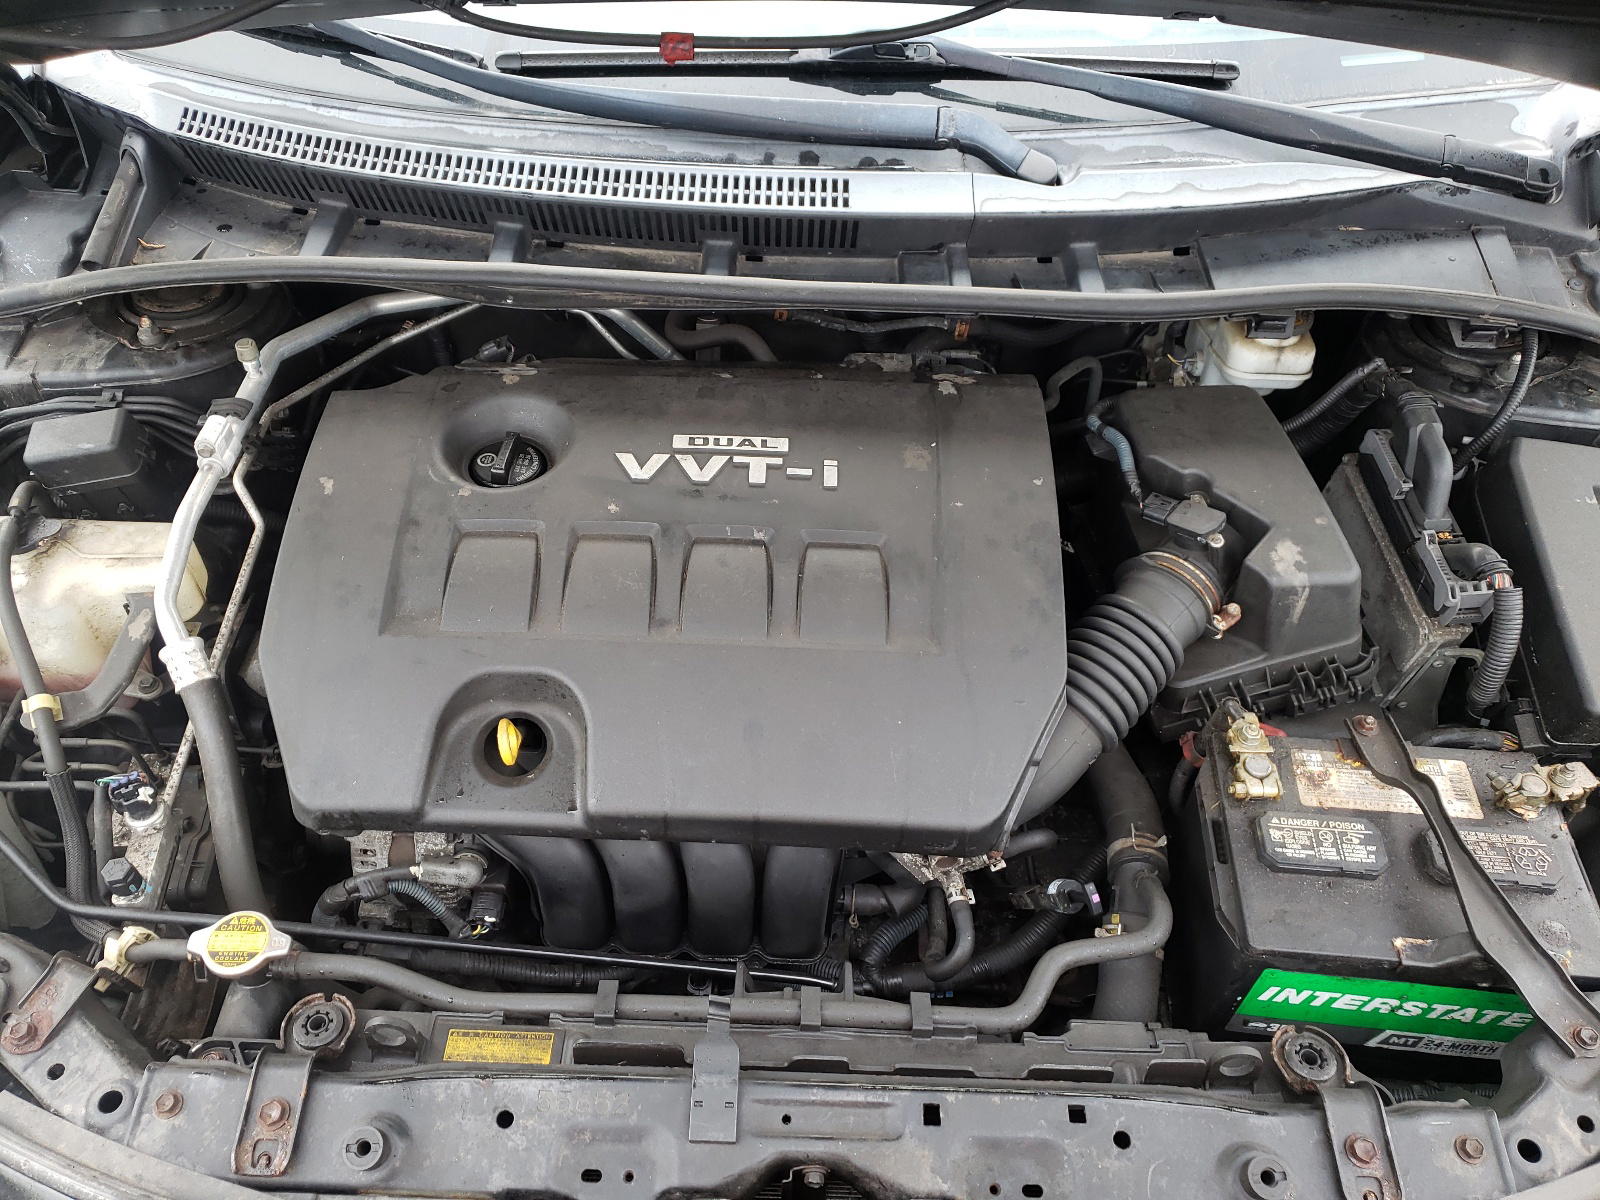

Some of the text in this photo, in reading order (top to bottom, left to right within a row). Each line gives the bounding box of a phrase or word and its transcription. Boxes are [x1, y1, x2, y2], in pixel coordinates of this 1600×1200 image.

[687, 436, 779, 449] DUAL
[615, 452, 838, 489] VVT-i
[1280, 819, 1320, 828] DANGER
[1329, 821, 1366, 831] POISON
[220, 924, 263, 932] CAUTION
[1256, 985, 1535, 1028] INTERSTATE
[1389, 1036, 1500, 1054] MT 24-MONTH
